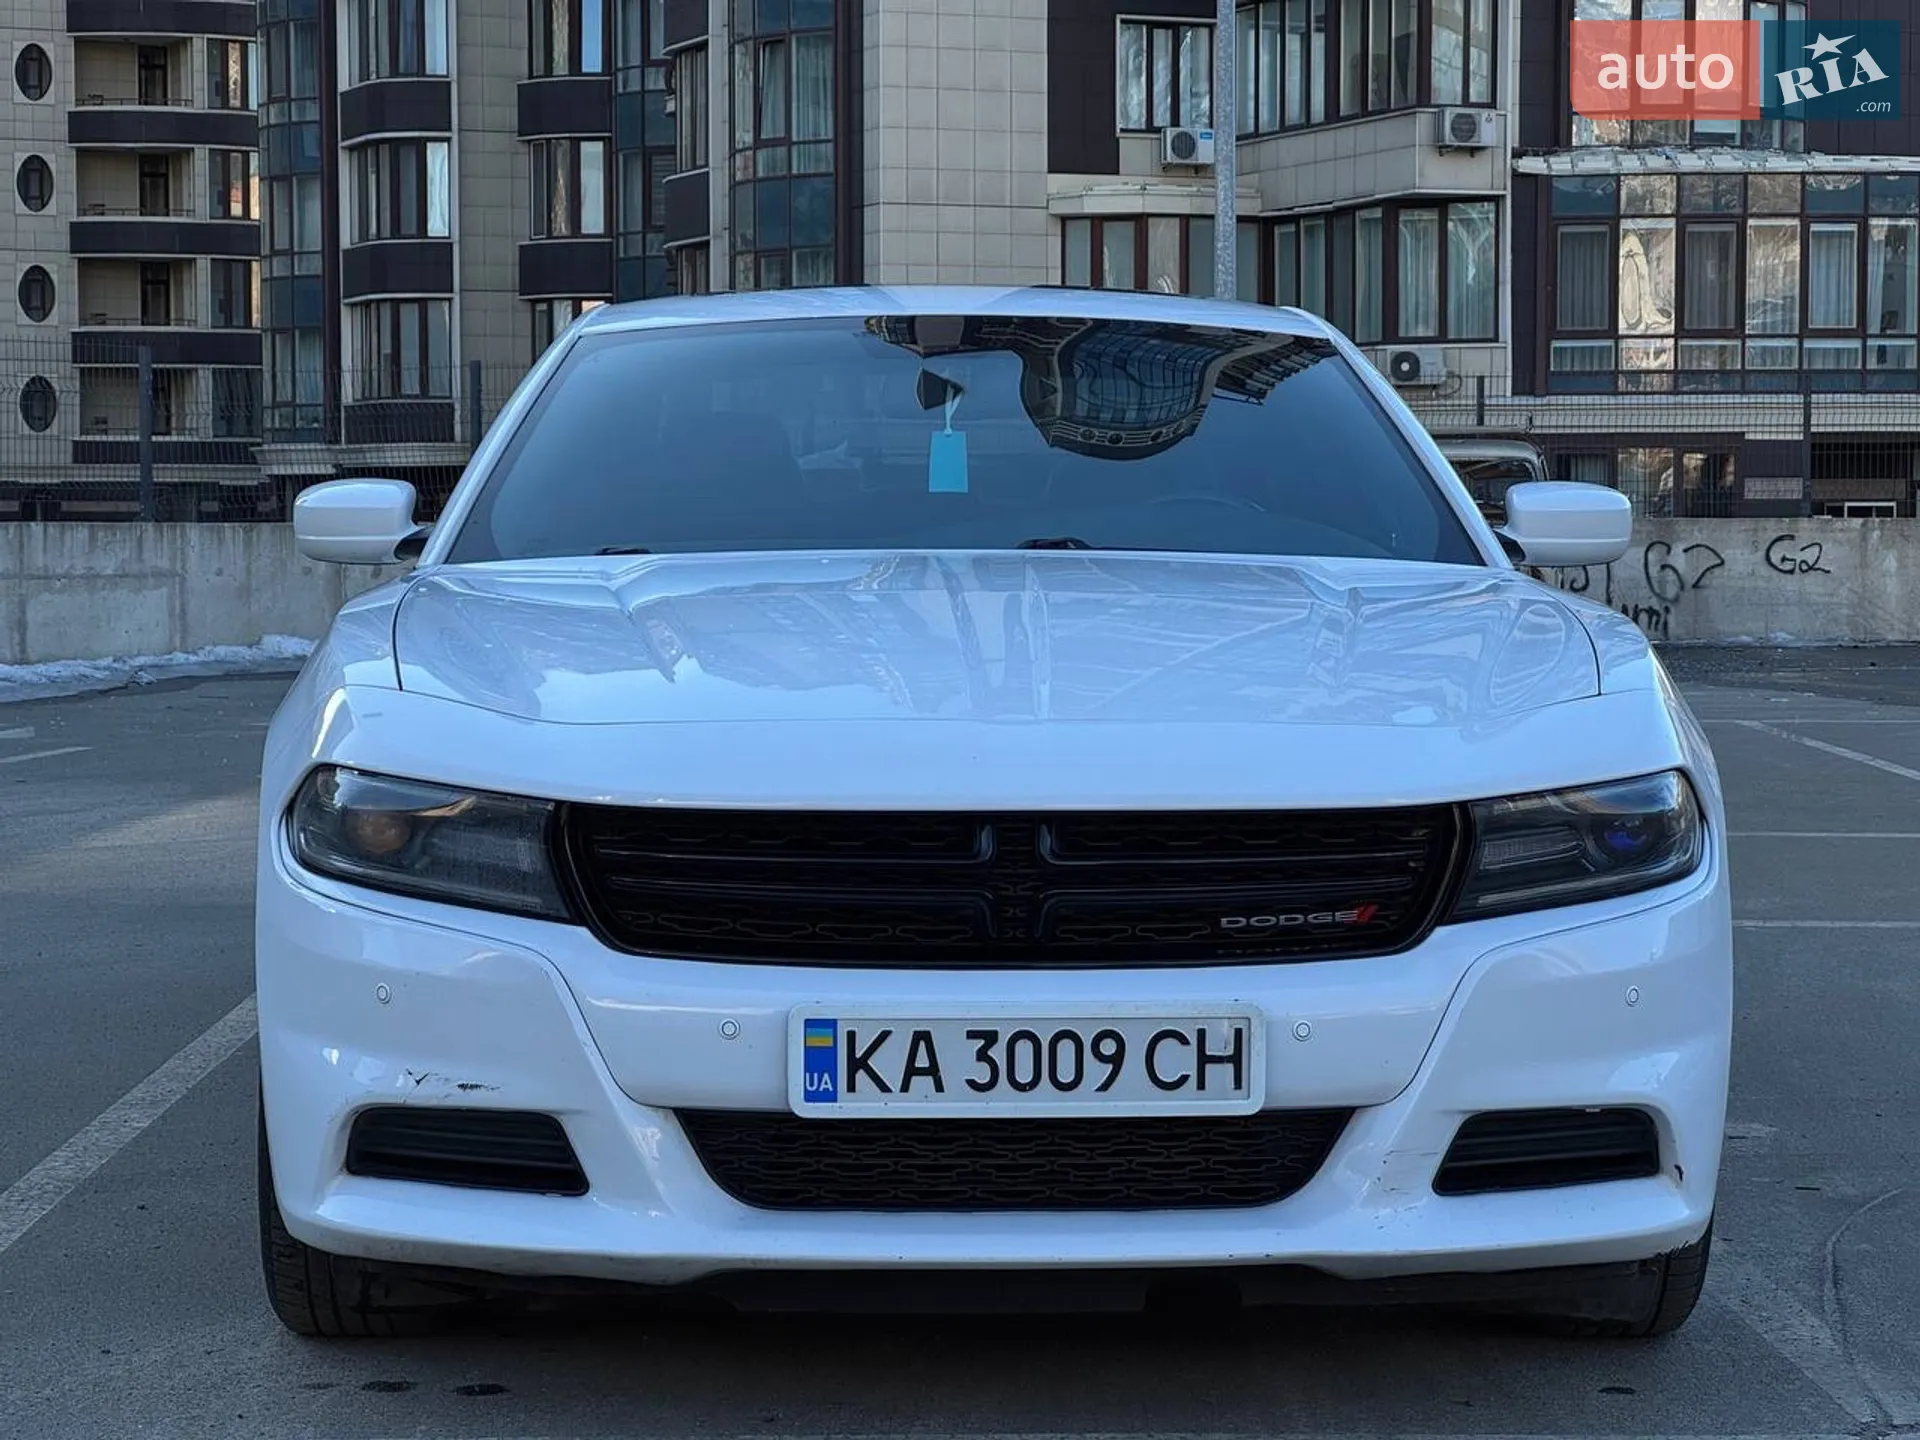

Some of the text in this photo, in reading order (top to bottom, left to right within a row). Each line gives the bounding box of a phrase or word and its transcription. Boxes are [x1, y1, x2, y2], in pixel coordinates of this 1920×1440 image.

[1765, 534, 1831, 575] G2
[1220, 910, 1359, 928] DODGE
[846, 1027, 1243, 1093] KA 3009 CH
[805, 1072, 833, 1092] UA
